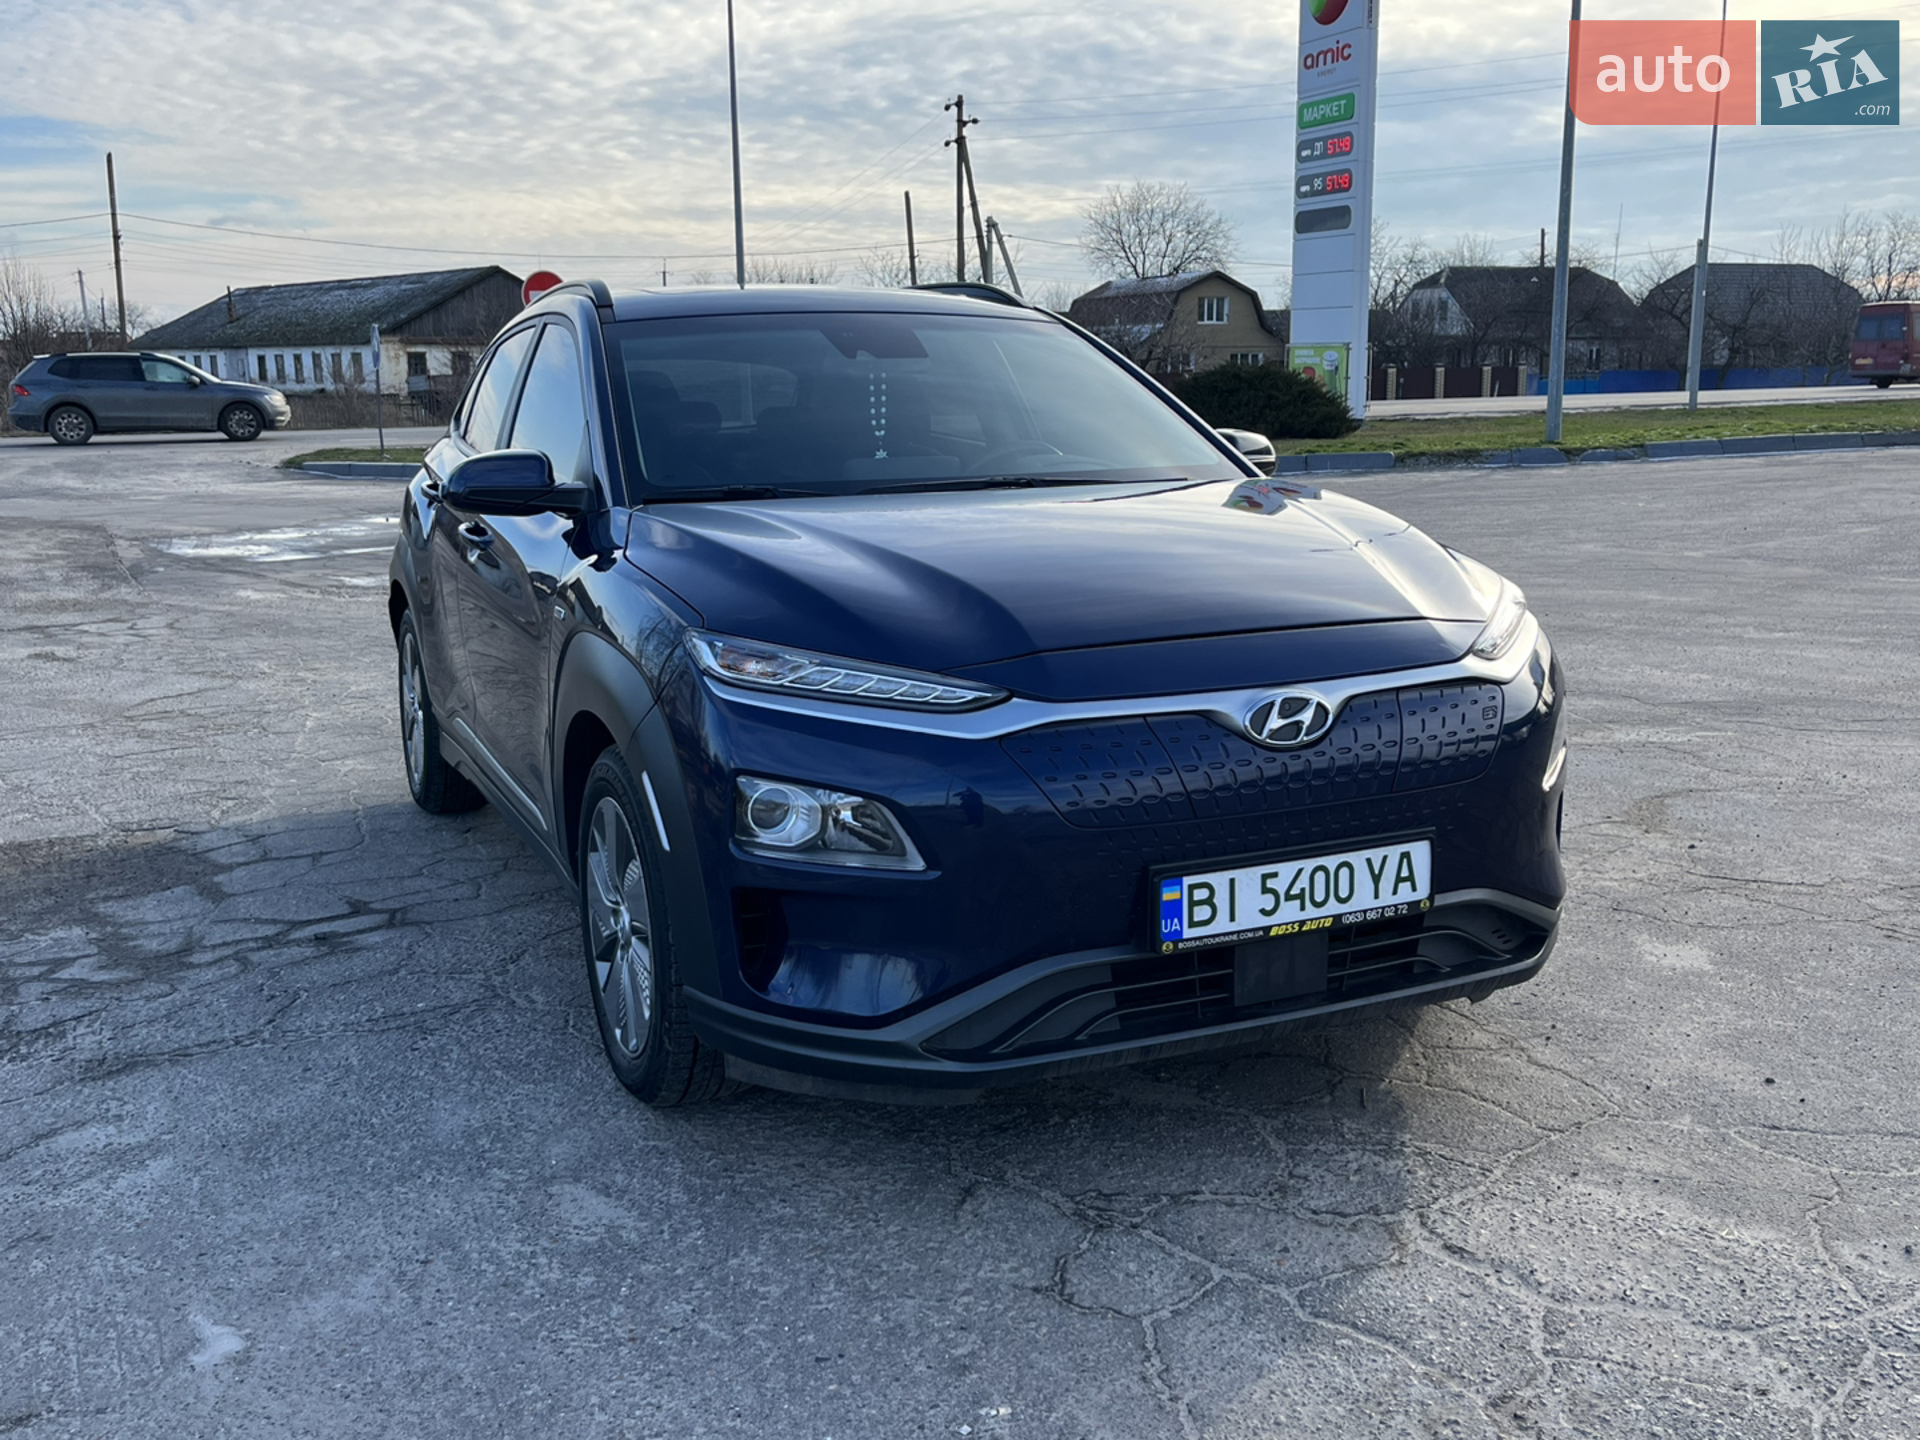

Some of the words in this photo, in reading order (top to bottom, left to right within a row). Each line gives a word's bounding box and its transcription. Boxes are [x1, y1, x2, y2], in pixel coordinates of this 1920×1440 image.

[1303, 39, 1352, 71] amic
[1303, 100, 1347, 122] МАРКЕТ
[1313, 177, 1323, 191] 95
[1188, 877, 1236, 929] BI
[1258, 860, 1355, 918] 5400
[1365, 851, 1418, 900] YA
[1341, 913, 1364, 924] (063)
[1366, 909, 1382, 920] 667
[1384, 907, 1395, 917] 02
[1397, 904, 1408, 914] 72
[1161, 918, 1181, 933] UA
[1269, 922, 1300, 936] BOSS
[1301, 917, 1334, 931] AUTO
